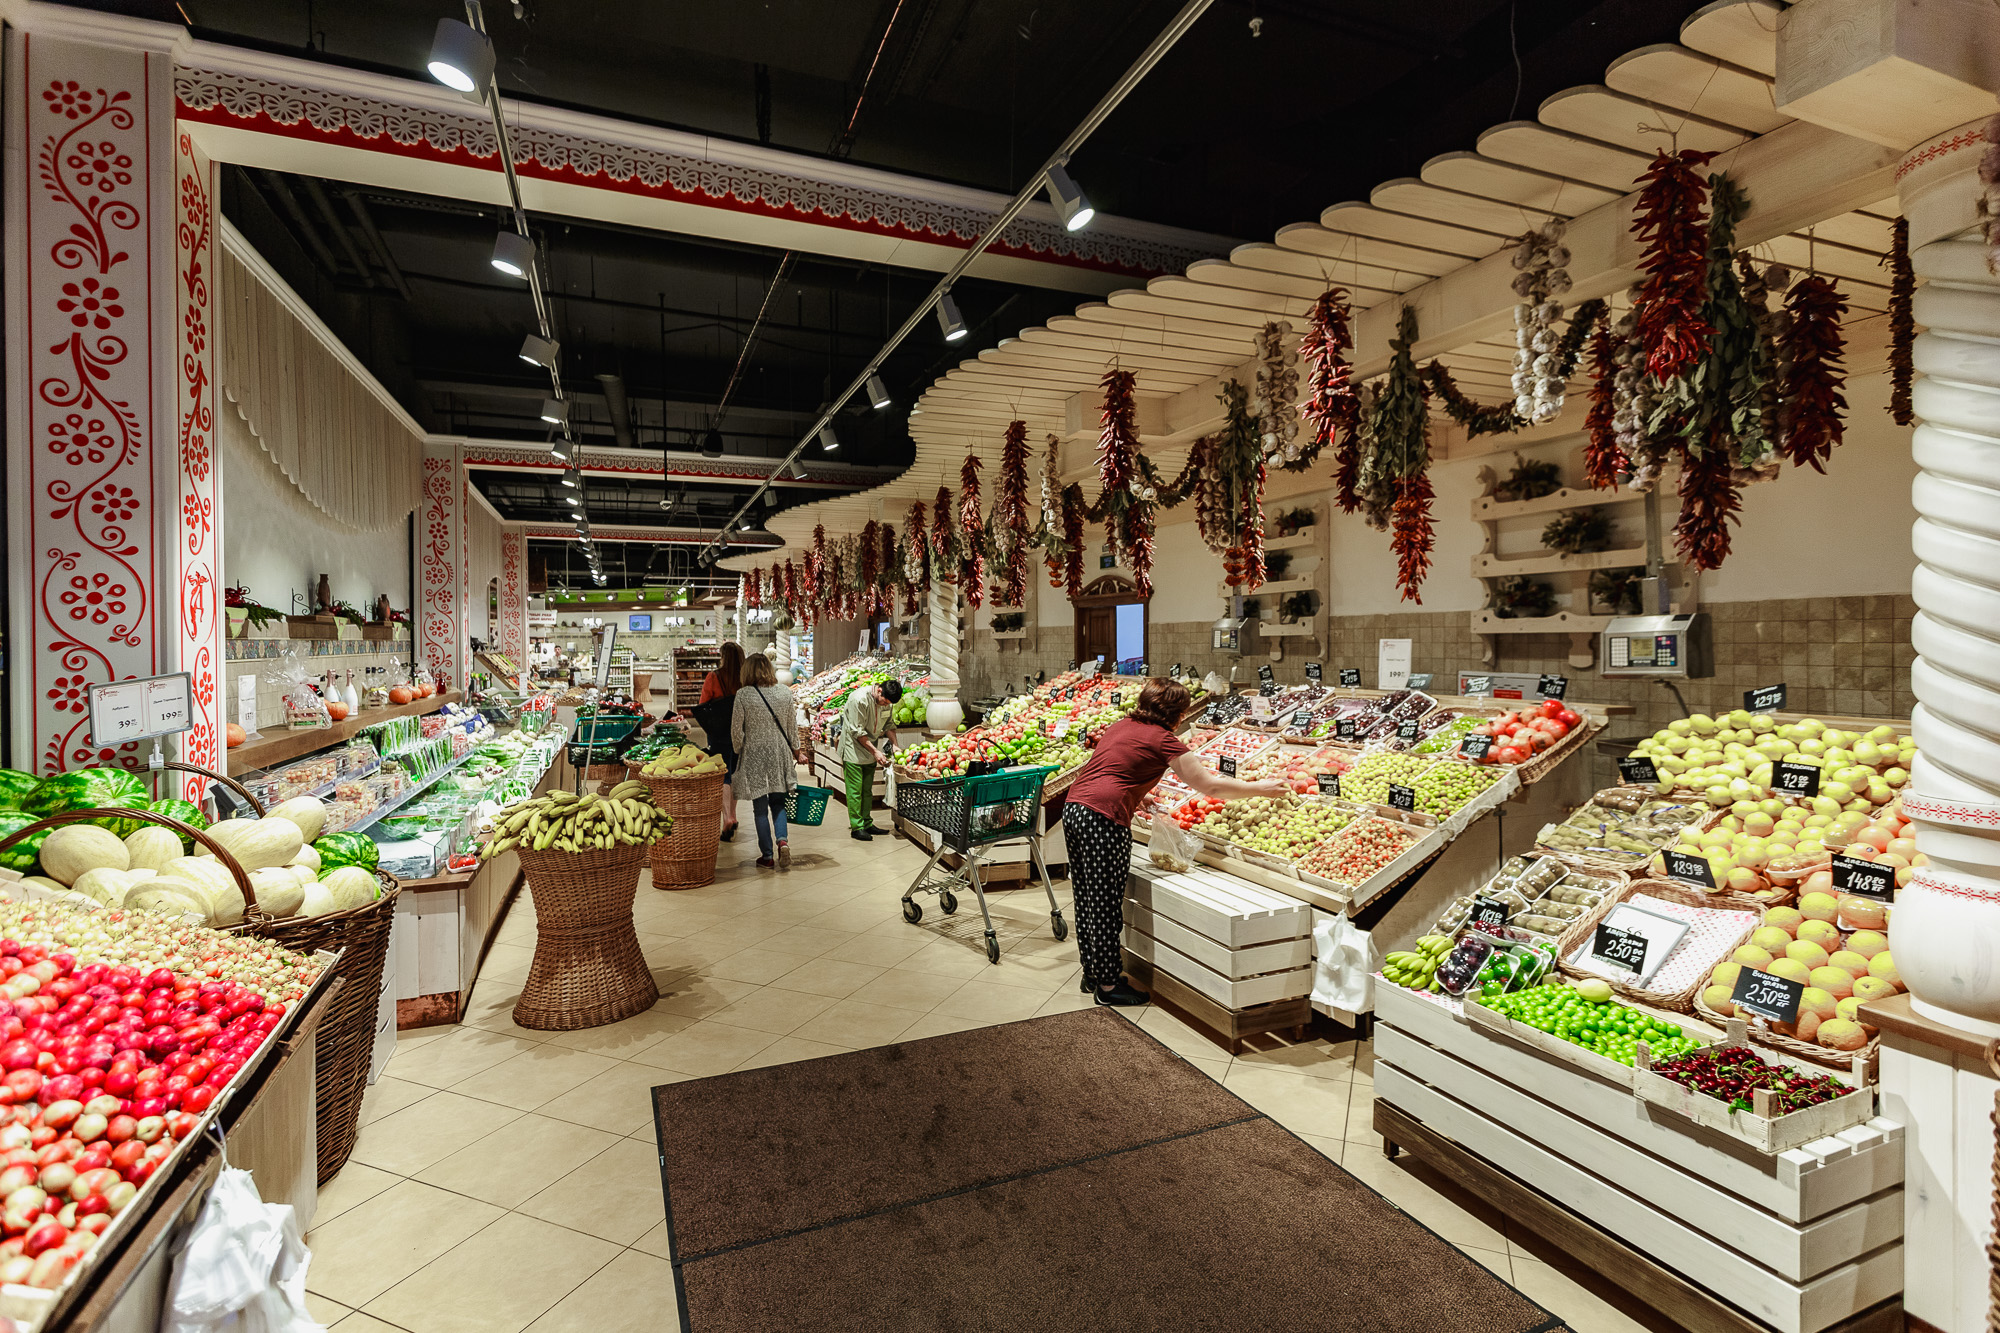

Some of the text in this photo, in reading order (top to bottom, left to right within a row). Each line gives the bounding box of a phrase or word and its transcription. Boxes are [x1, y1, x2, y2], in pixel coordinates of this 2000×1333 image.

[162, 712, 177, 720] 199
[118, 720, 131, 730] 39
[1672, 860, 1694, 875] 189
[1846, 872, 1873, 890] 148
[1604, 940, 1632, 959] 250
[1744, 984, 1778, 1004] 250
